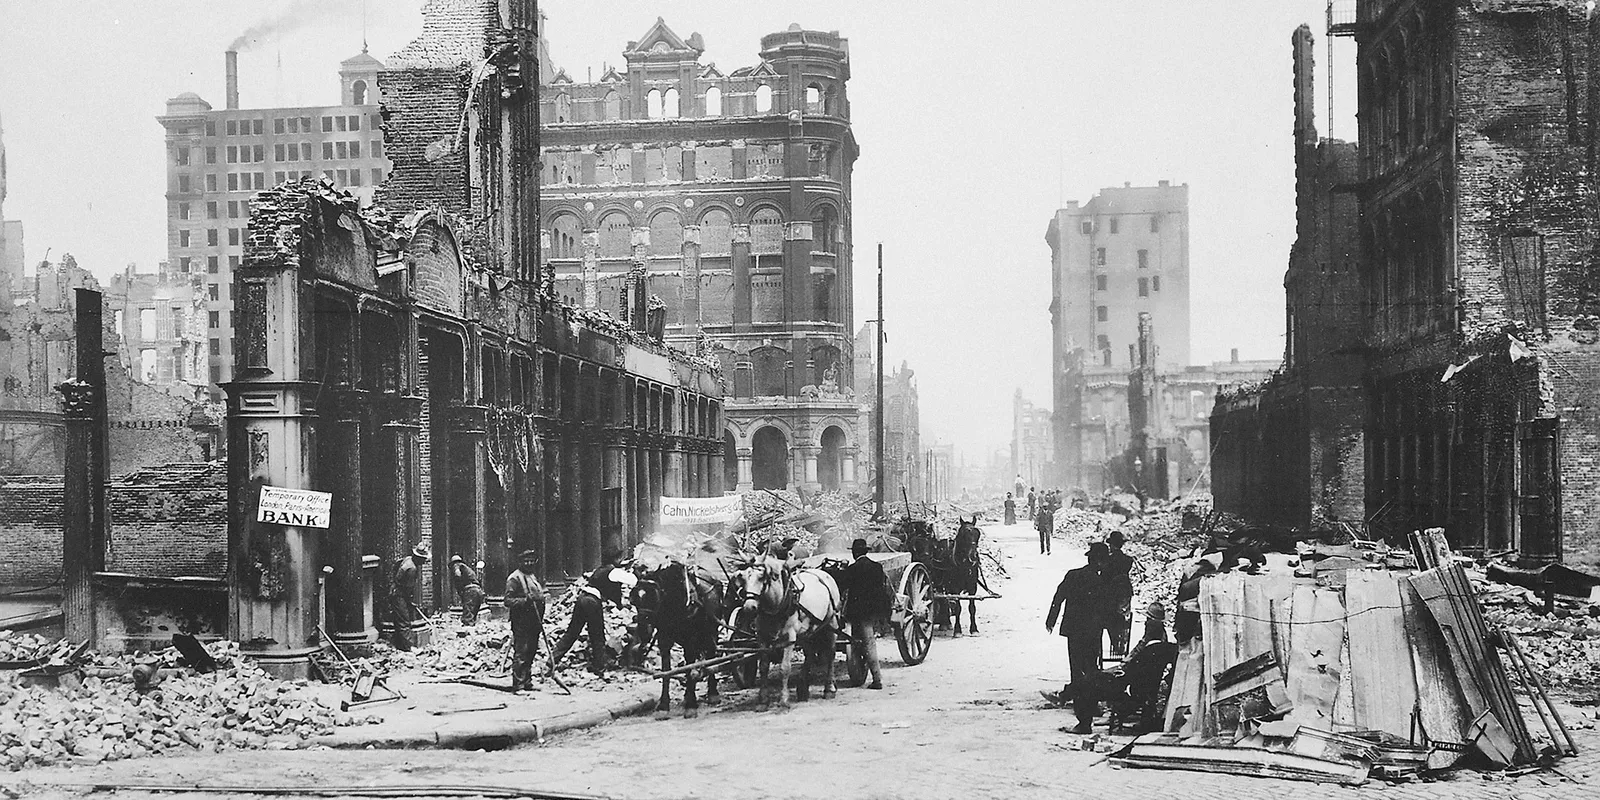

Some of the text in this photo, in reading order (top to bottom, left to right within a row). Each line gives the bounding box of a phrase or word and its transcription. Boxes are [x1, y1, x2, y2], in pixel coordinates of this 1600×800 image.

[264, 489, 329, 505] Temporary Office
[263, 510, 318, 526] BANK
